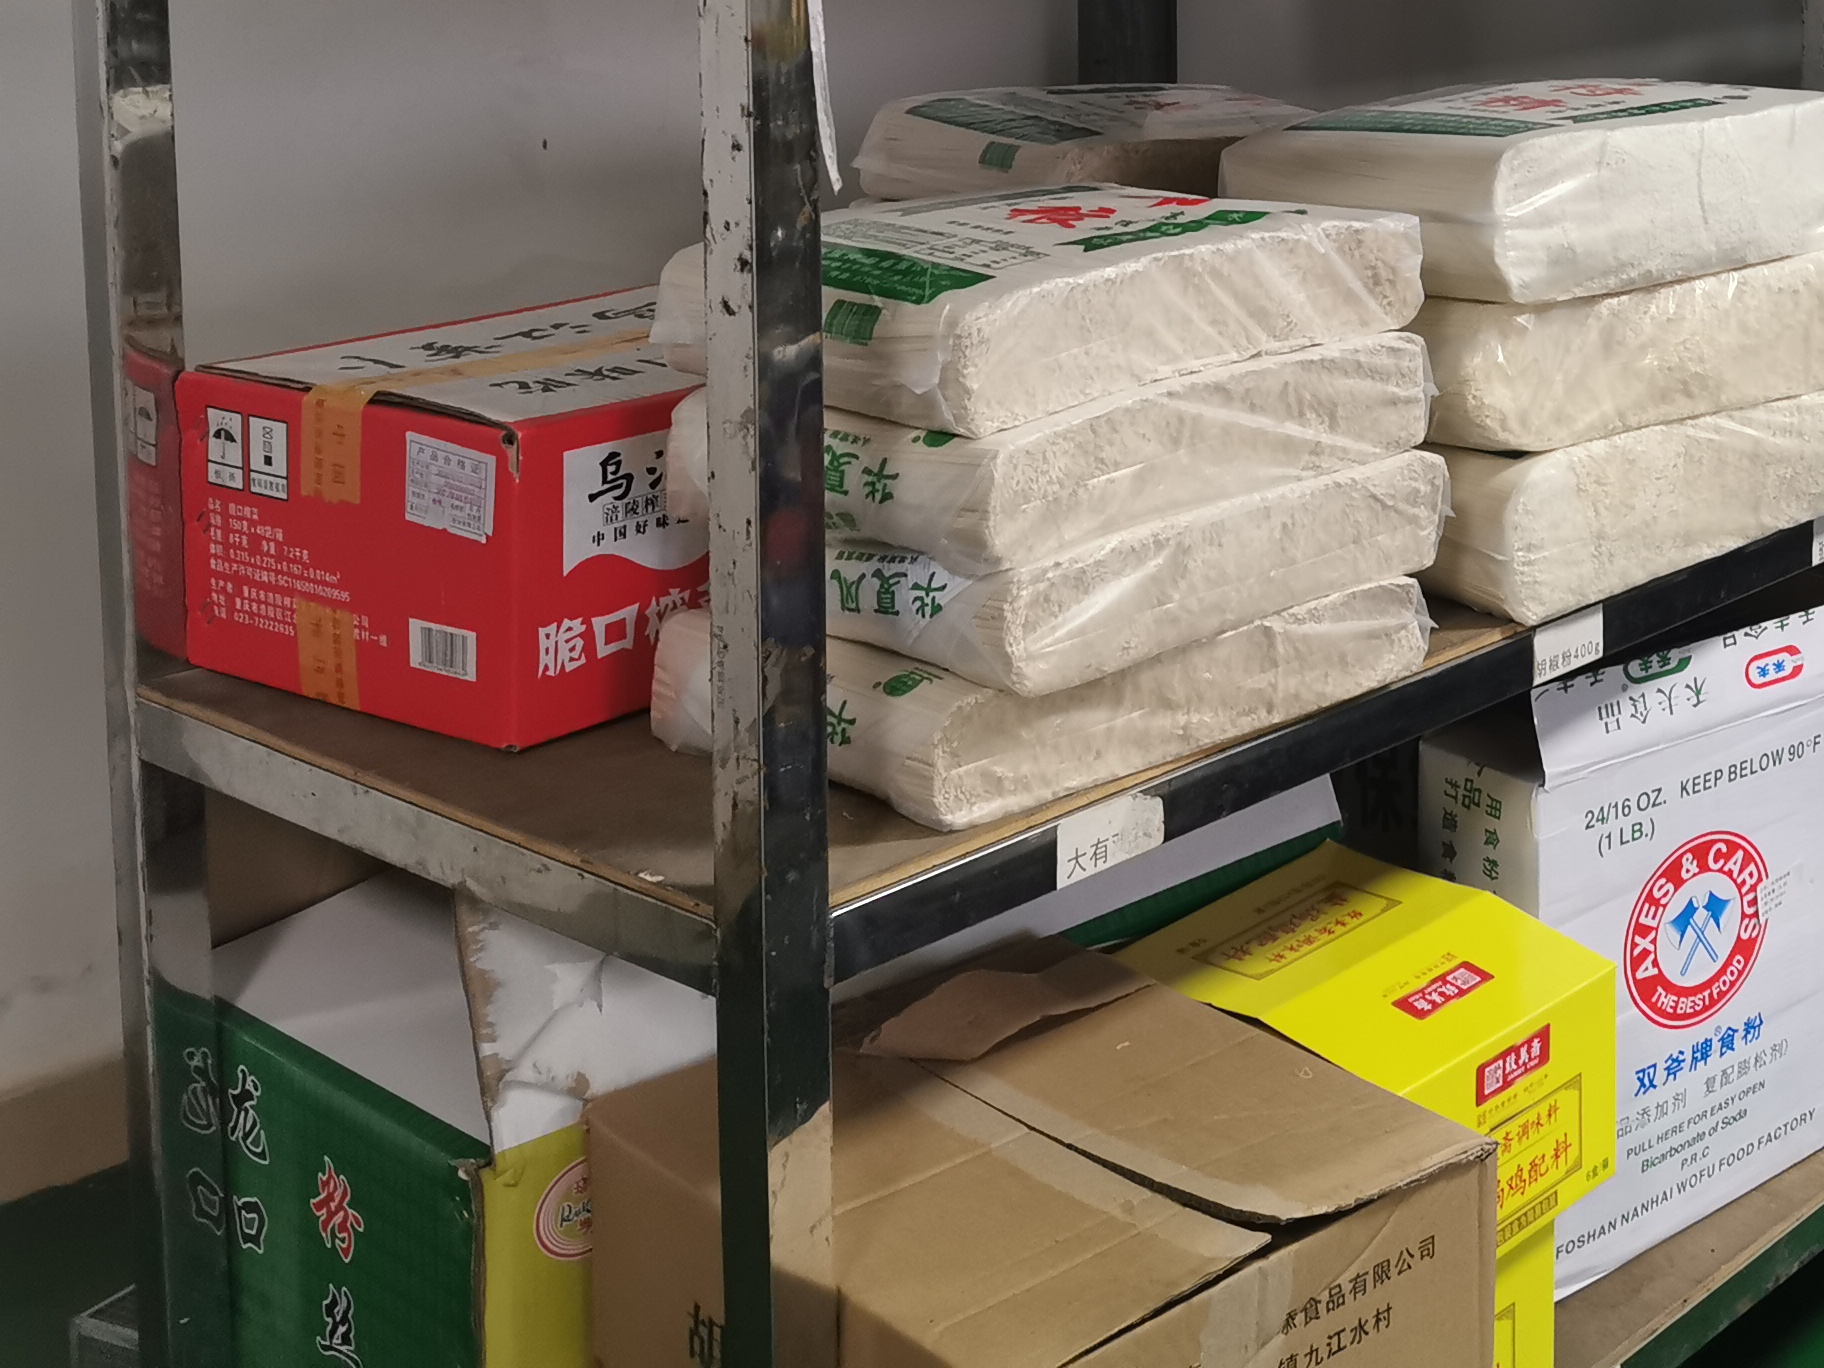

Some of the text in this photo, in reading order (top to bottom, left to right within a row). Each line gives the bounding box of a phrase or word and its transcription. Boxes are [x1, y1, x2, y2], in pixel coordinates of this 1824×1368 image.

[602, 492, 666, 524] 涪陵榨
[830, 570, 949, 619] 华夏风
[1584, 798, 1632, 830] 24/16
[1637, 788, 1667, 812] OZ.
[1680, 769, 1724, 799] KEEP
[1728, 748, 1785, 783] BELOW
[1620, 818, 1655, 847] LB.)
[1633, 877, 1675, 980] AXES
[1681, 852, 1700, 880] &
[1651, 954, 1745, 1014] THE BEST FOOD
[1626, 1079, 1765, 1160] PULL HERE FOR EASY OPEN
[1641, 1108, 1748, 1174] Bicarbonate of Soda
[1555, 1108, 1816, 1260] FOSHAN NANHAI WOFU FOOD FACTORY
